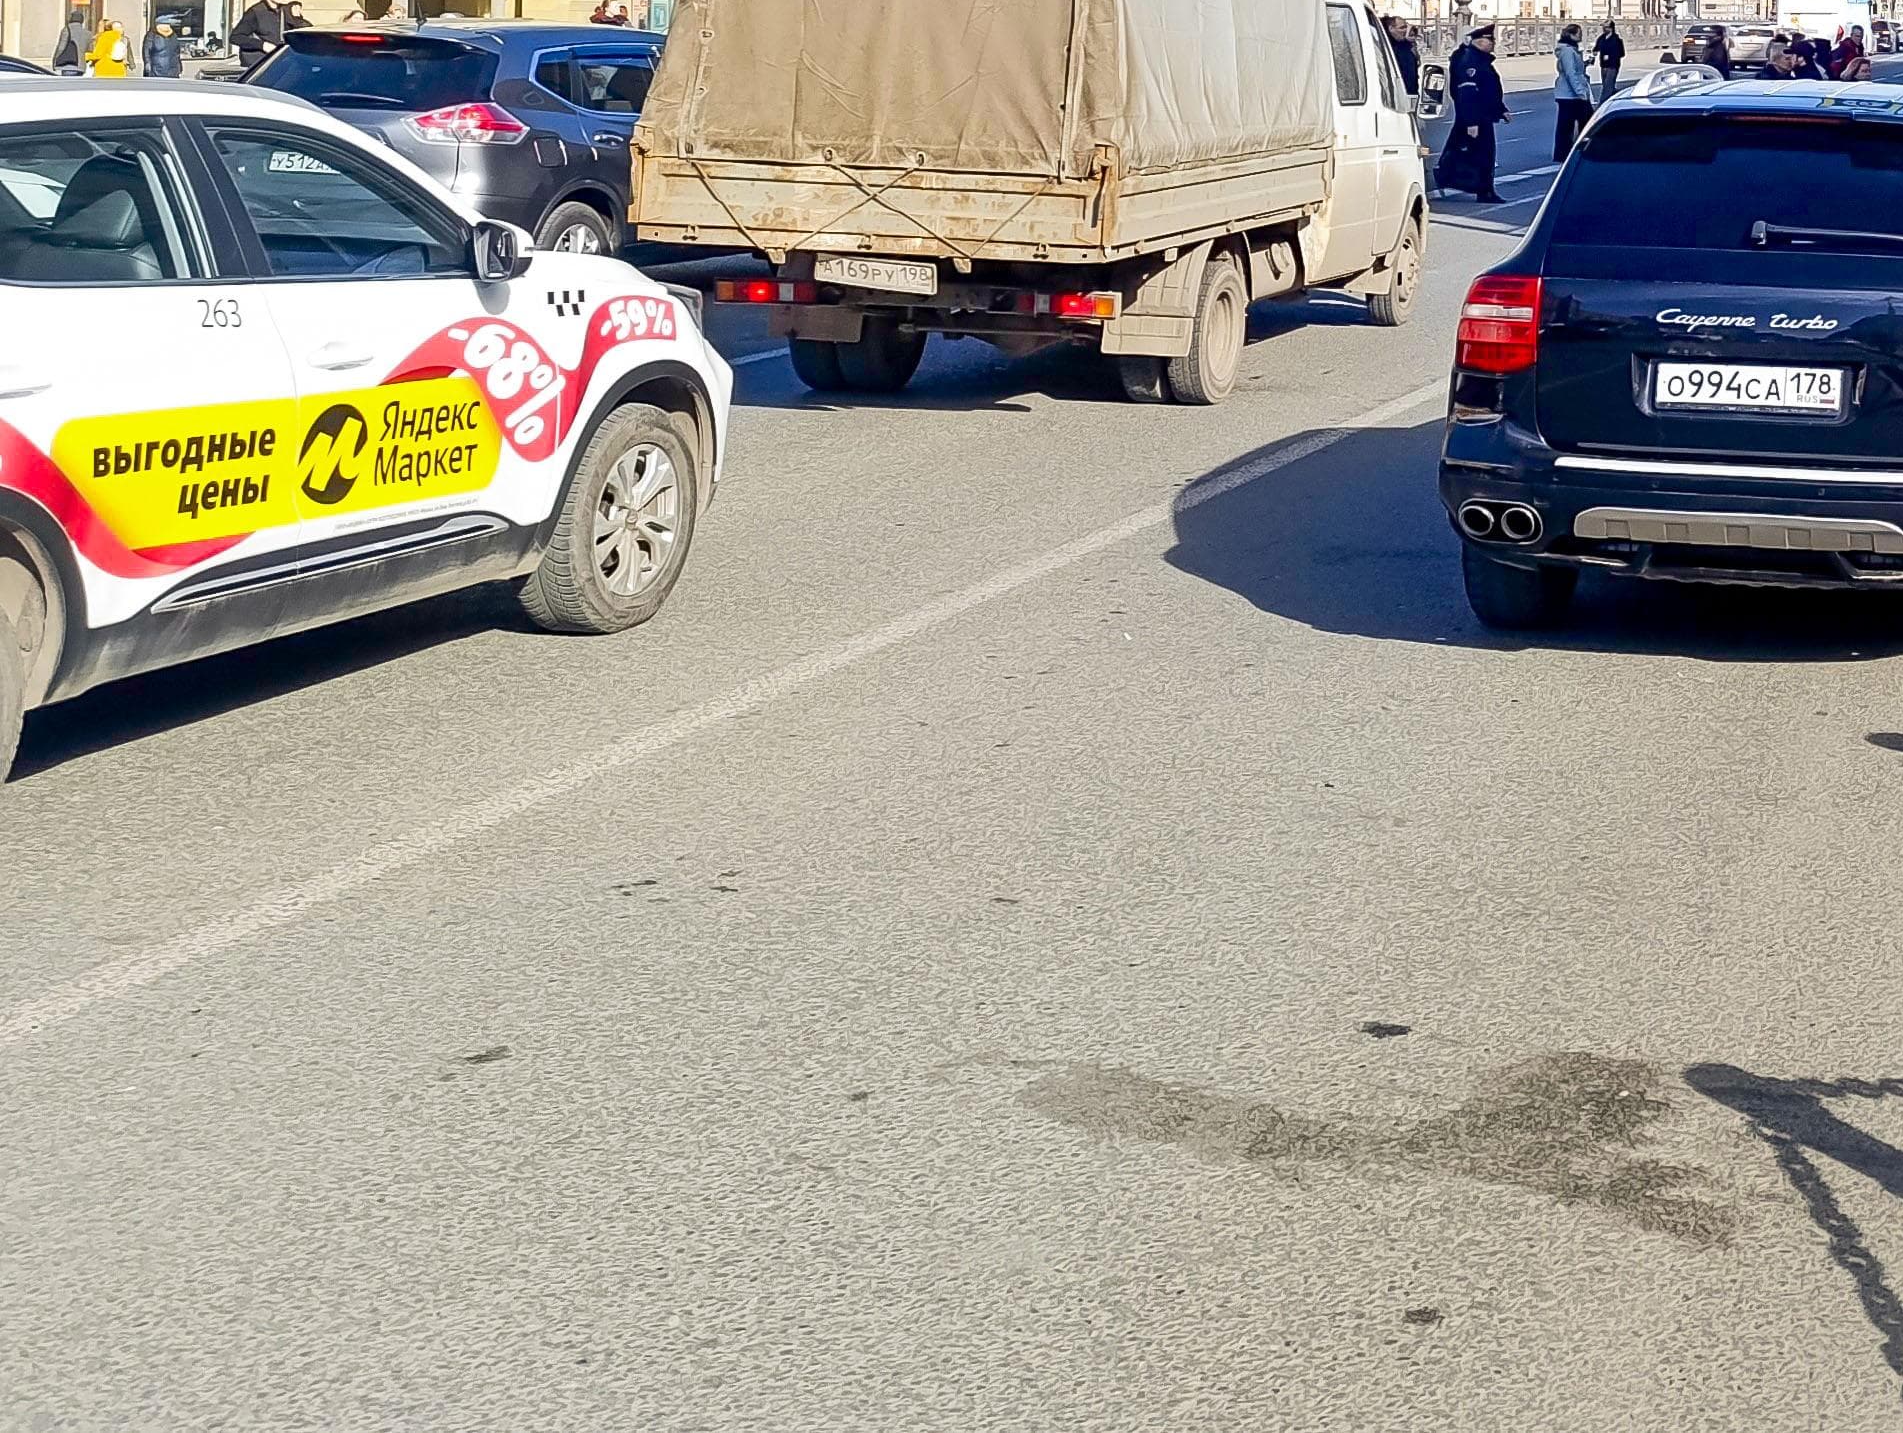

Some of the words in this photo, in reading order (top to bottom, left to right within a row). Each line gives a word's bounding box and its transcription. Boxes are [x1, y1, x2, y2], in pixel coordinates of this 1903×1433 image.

[823, 259, 896, 282] А169РУ
[899, 267, 929, 282] 198
[197, 299, 243, 328] 263
[600, 298, 673, 341] -59%
[1656, 308, 1756, 333] Cayenne
[448, 324, 566, 445] -68%
[1667, 369, 1782, 401] О994СА
[1790, 372, 1832, 395] 178
[1796, 394, 1818, 404] RUS
[379, 400, 481, 442] Яндекс
[92, 427, 276, 478] выгодные
[374, 443, 478, 486] Маркет
[177, 474, 270, 519] цены
